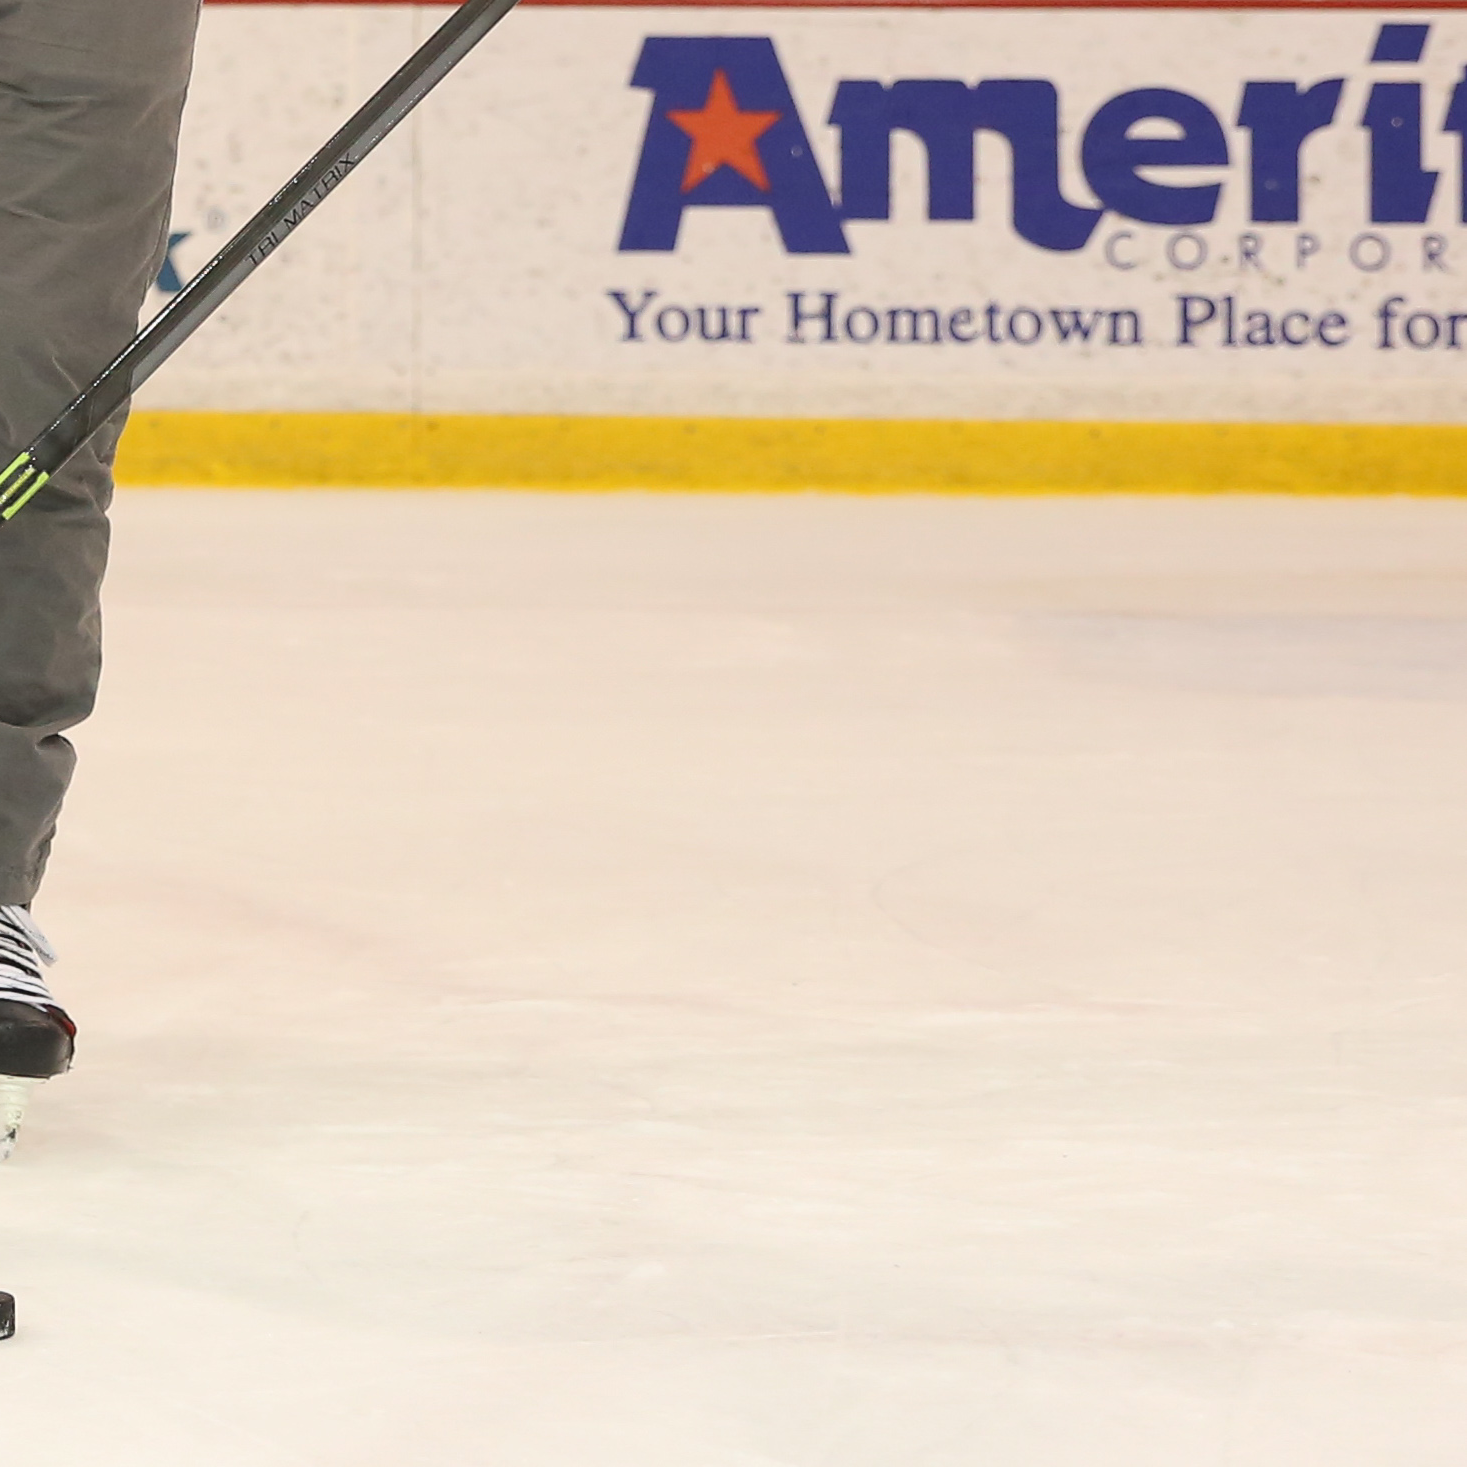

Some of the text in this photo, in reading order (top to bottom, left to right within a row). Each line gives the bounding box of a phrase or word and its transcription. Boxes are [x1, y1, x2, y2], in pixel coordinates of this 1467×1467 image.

[618, 24, 1467, 254] Ameri
[245, 152, 355, 266] TRI MATRIX
[607, 289, 1467, 350] Your Hometown Place for
